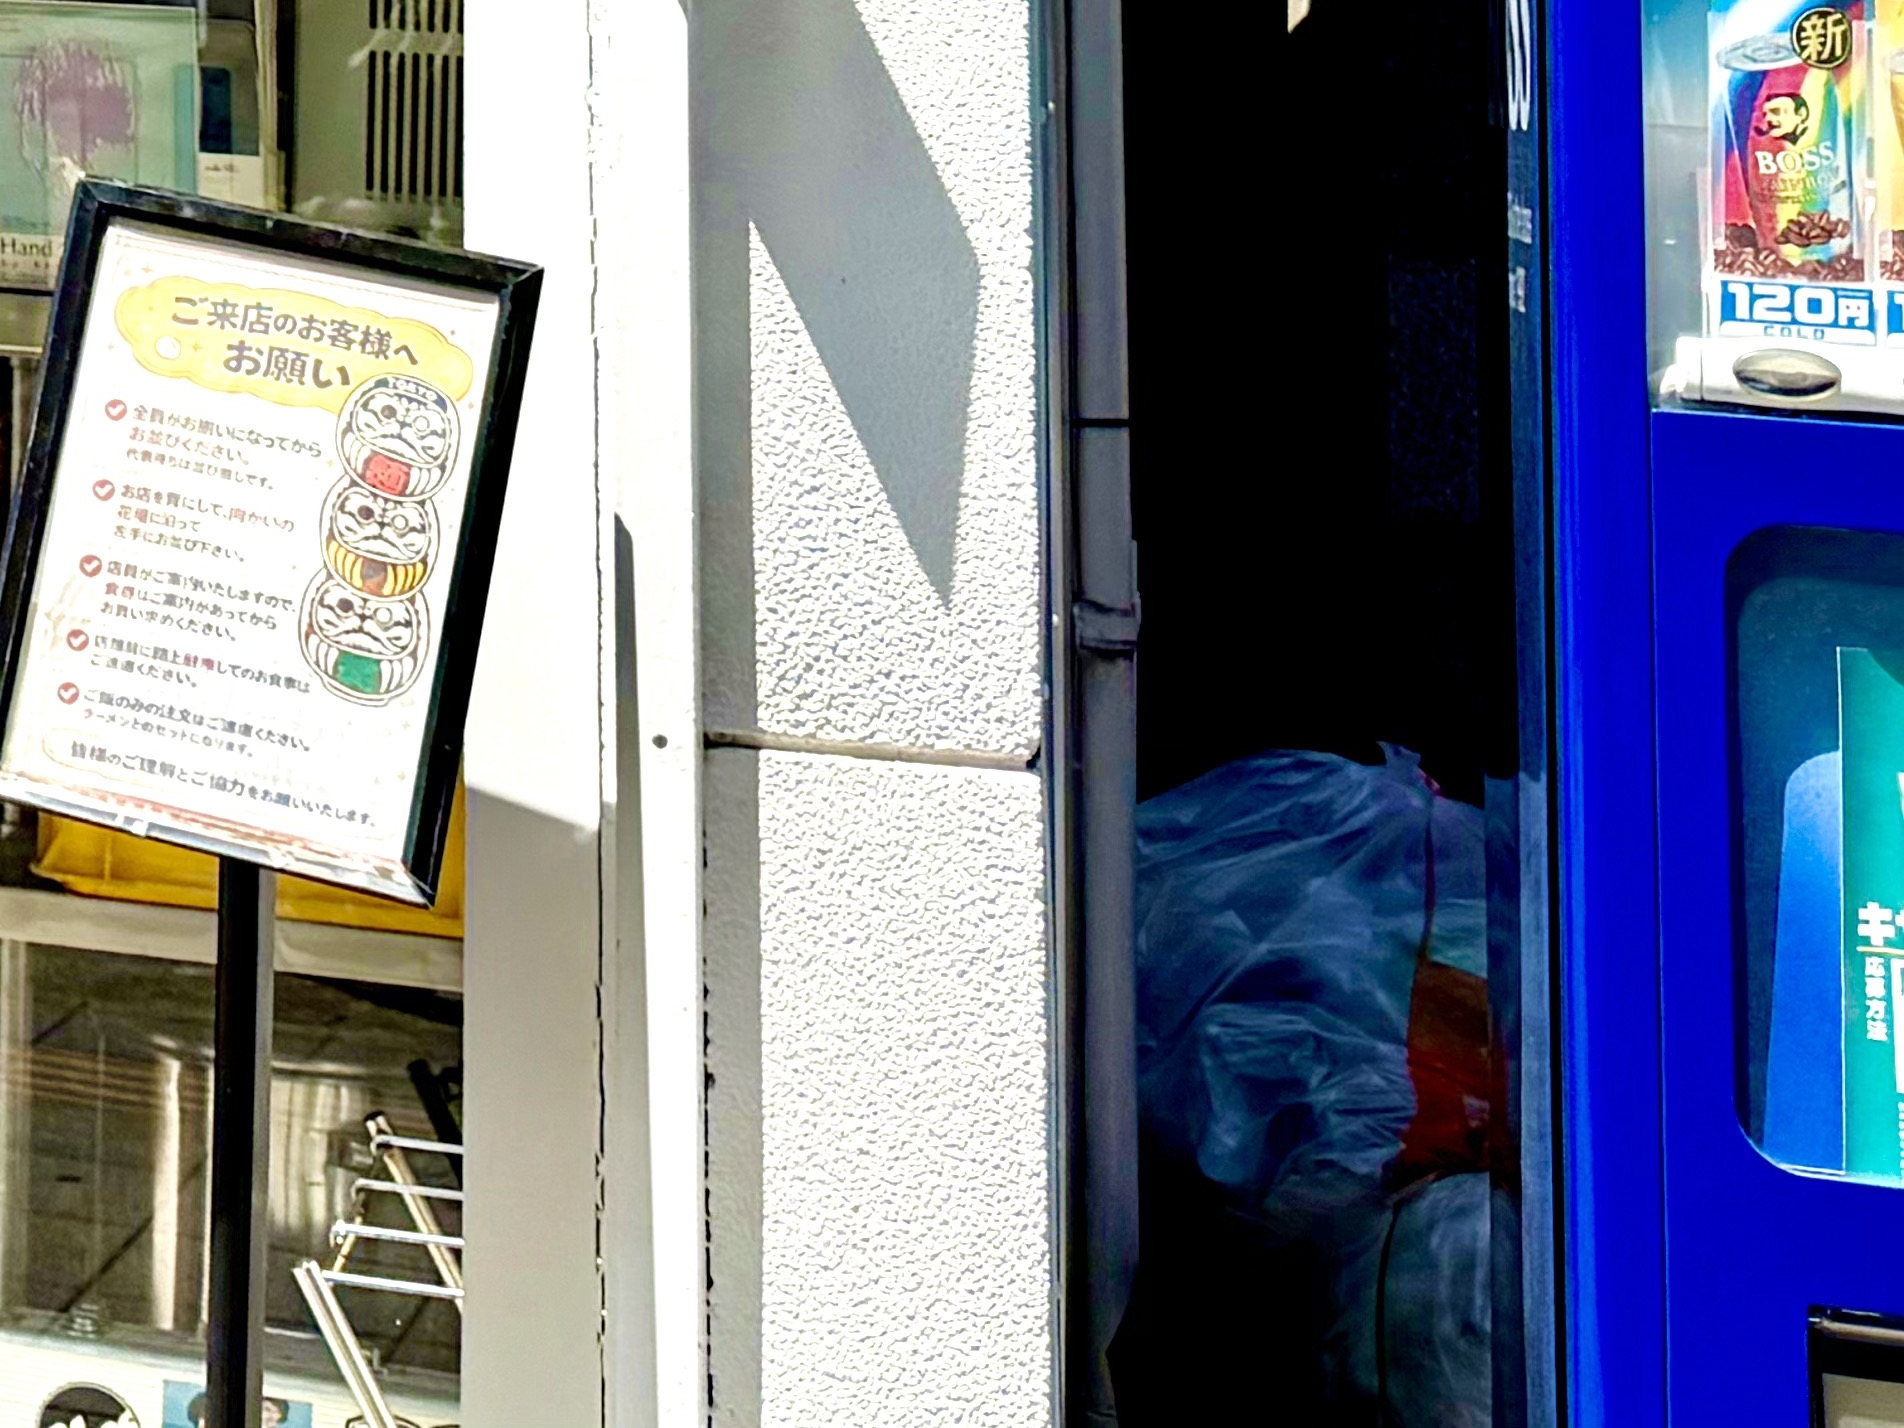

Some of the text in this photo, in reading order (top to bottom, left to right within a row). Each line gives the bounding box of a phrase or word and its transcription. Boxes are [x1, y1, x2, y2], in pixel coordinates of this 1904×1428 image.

[1799, 13, 1849, 62] 新
[1754, 141, 1834, 174] BOSS
[0, 237, 53, 258] Hand
[1727, 282, 1870, 328] 120円
[171, 296, 419, 366] ご来店のお客様へ
[1763, 325, 1826, 340] COLD
[223, 340, 351, 389] お願い
[1857, 901, 1904, 947] キ
